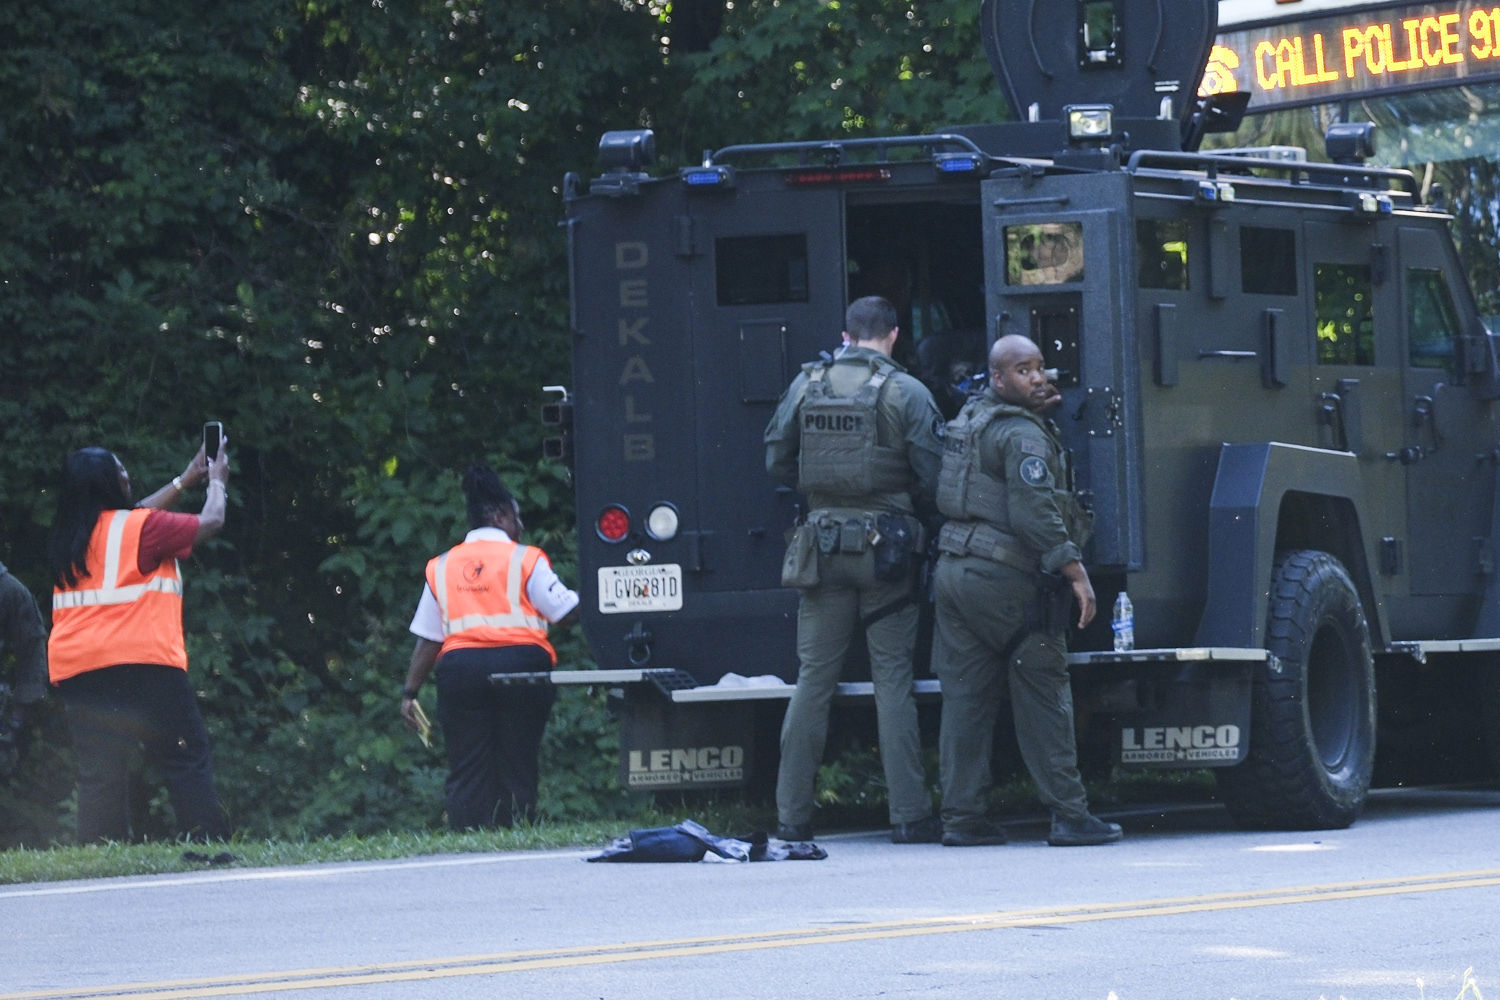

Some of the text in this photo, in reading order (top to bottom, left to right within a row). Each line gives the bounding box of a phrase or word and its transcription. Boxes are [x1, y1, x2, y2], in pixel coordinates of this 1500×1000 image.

[1255, 34, 1338, 90] CALL
[1343, 13, 1464, 78] POLICE
[616, 241, 655, 461] DEKALB
[1122, 724, 1239, 749] LENCO
[629, 746, 743, 771] LENCO
[1123, 748, 1237, 761] ARMORED VEHICLES
